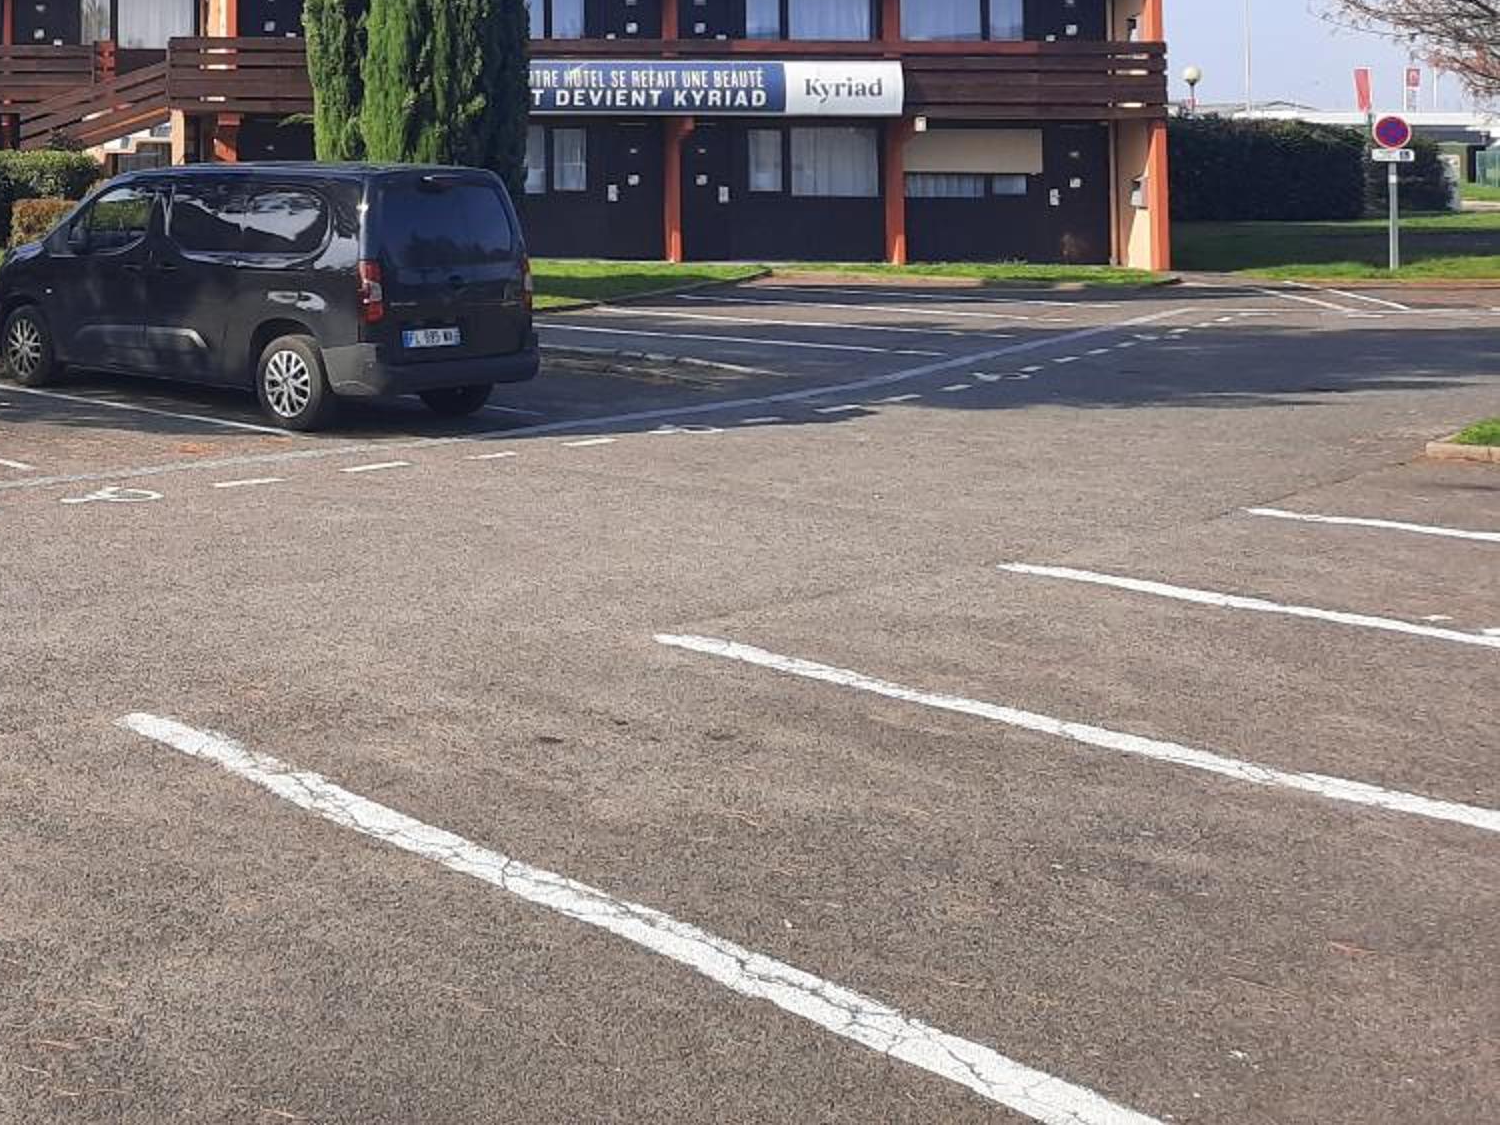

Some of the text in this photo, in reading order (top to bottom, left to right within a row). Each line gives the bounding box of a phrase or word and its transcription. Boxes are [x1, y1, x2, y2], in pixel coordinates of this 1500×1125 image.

[611, 70, 627, 88] SE
[631, 70, 677, 88] REFAIT
[681, 70, 709, 88] UNE
[531, 88, 767, 106] T DEVIENT KYRIAD
[804, 77, 883, 104] Kyriad
